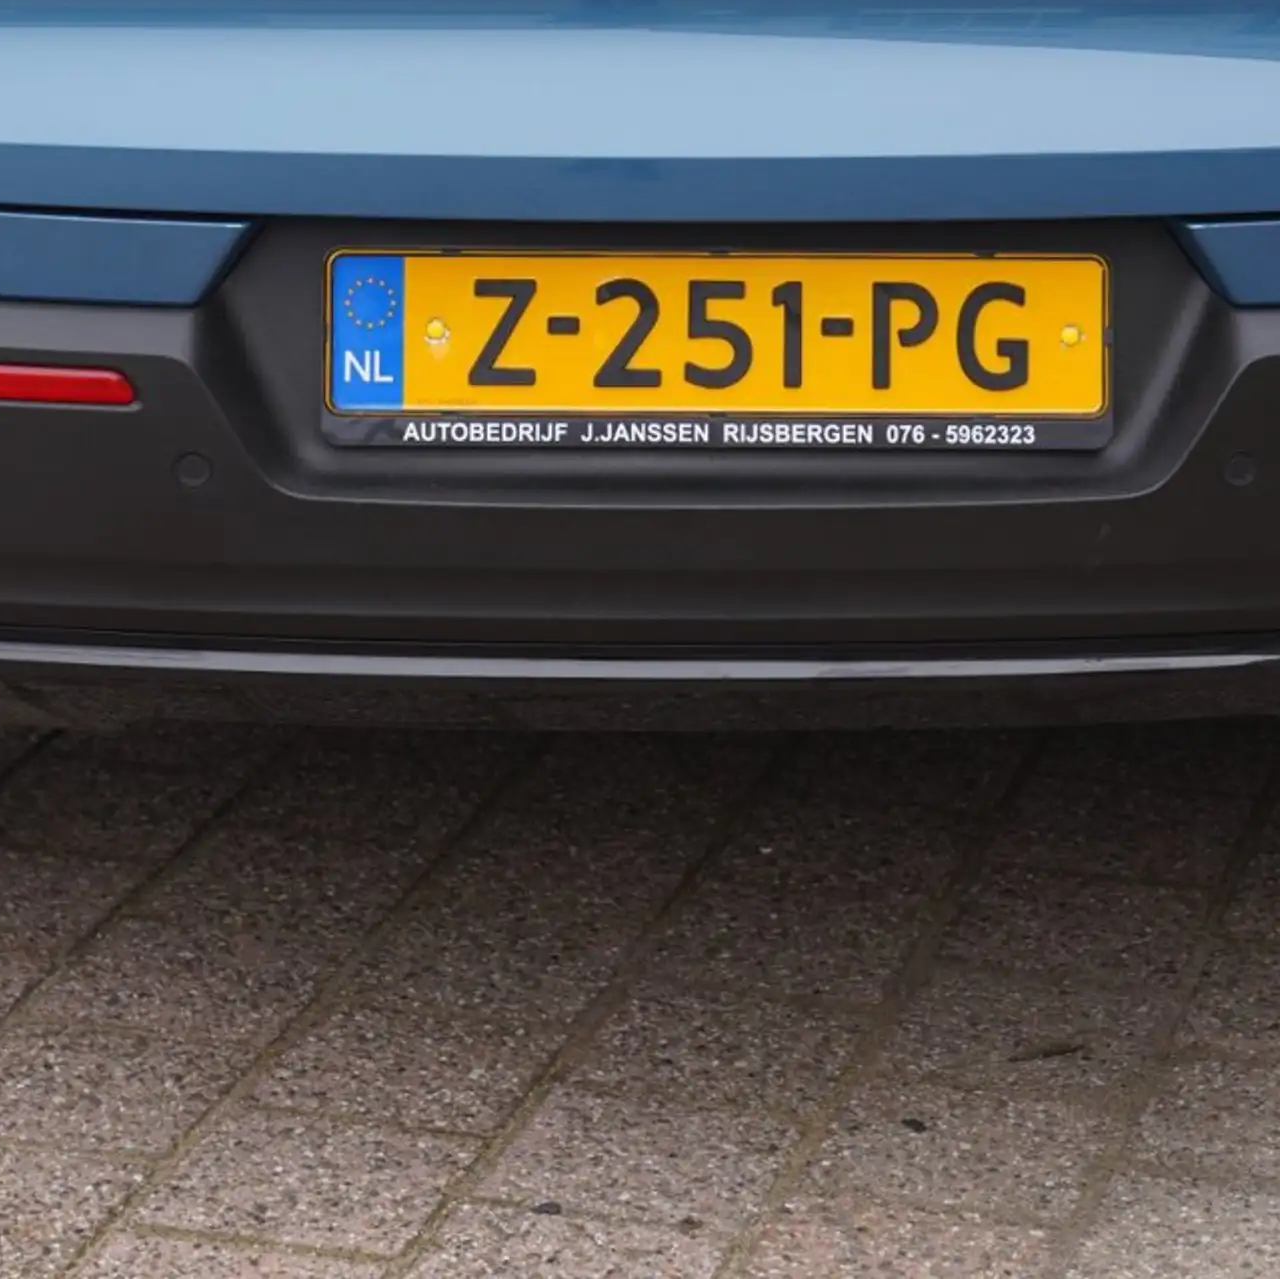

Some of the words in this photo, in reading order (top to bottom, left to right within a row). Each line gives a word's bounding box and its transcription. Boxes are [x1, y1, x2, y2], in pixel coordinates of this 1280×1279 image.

[468, 277, 1030, 391] Z-251-PG
[343, 350, 394, 382] NL
[403, 421, 568, 443] AUTOBEDRIJF
[581, 422, 710, 443] J.JANSSEN
[722, 423, 873, 445] RIJSBERGEN
